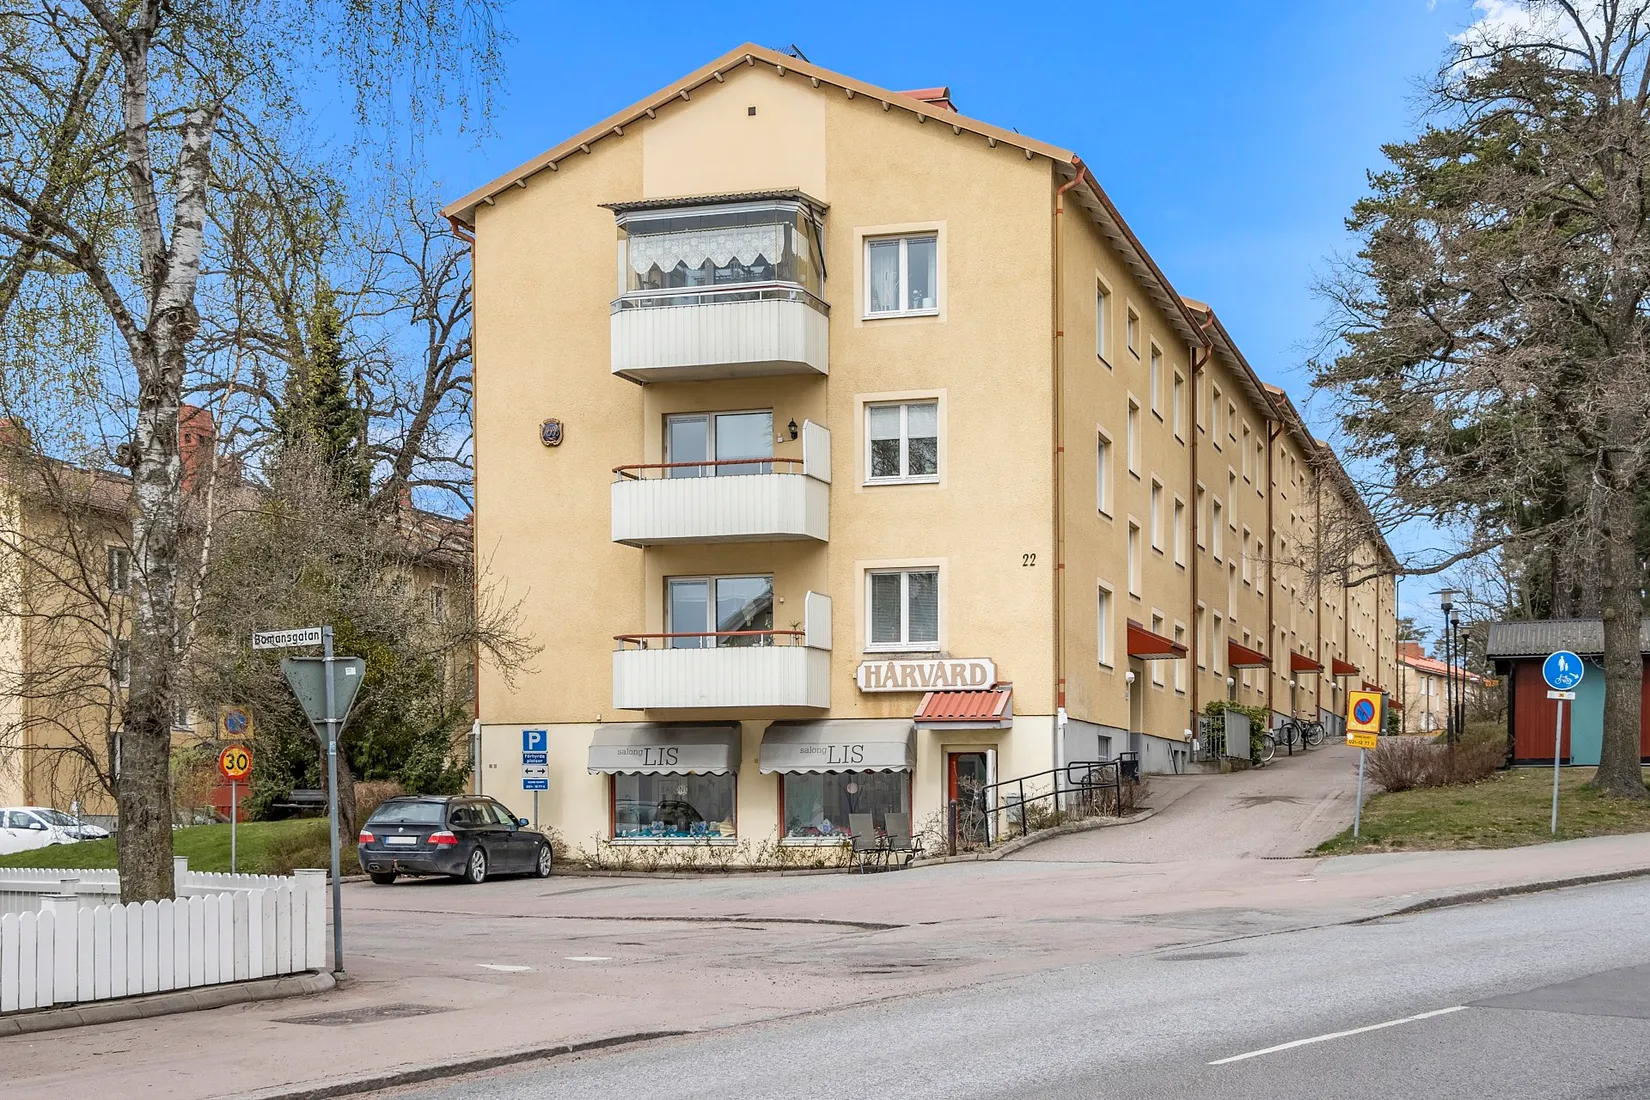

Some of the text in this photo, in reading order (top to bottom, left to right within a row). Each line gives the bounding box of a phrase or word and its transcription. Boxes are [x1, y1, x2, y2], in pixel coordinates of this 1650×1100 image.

[1022, 553, 1036, 566] 22
[254, 631, 320, 645] Bomansgatan
[864, 661, 988, 688] HÅRVÅRD
[528, 732, 541, 750] P
[225, 753, 247, 771] 30
[617, 747, 679, 766] salong LIS
[800, 744, 864, 764] salong LIS
